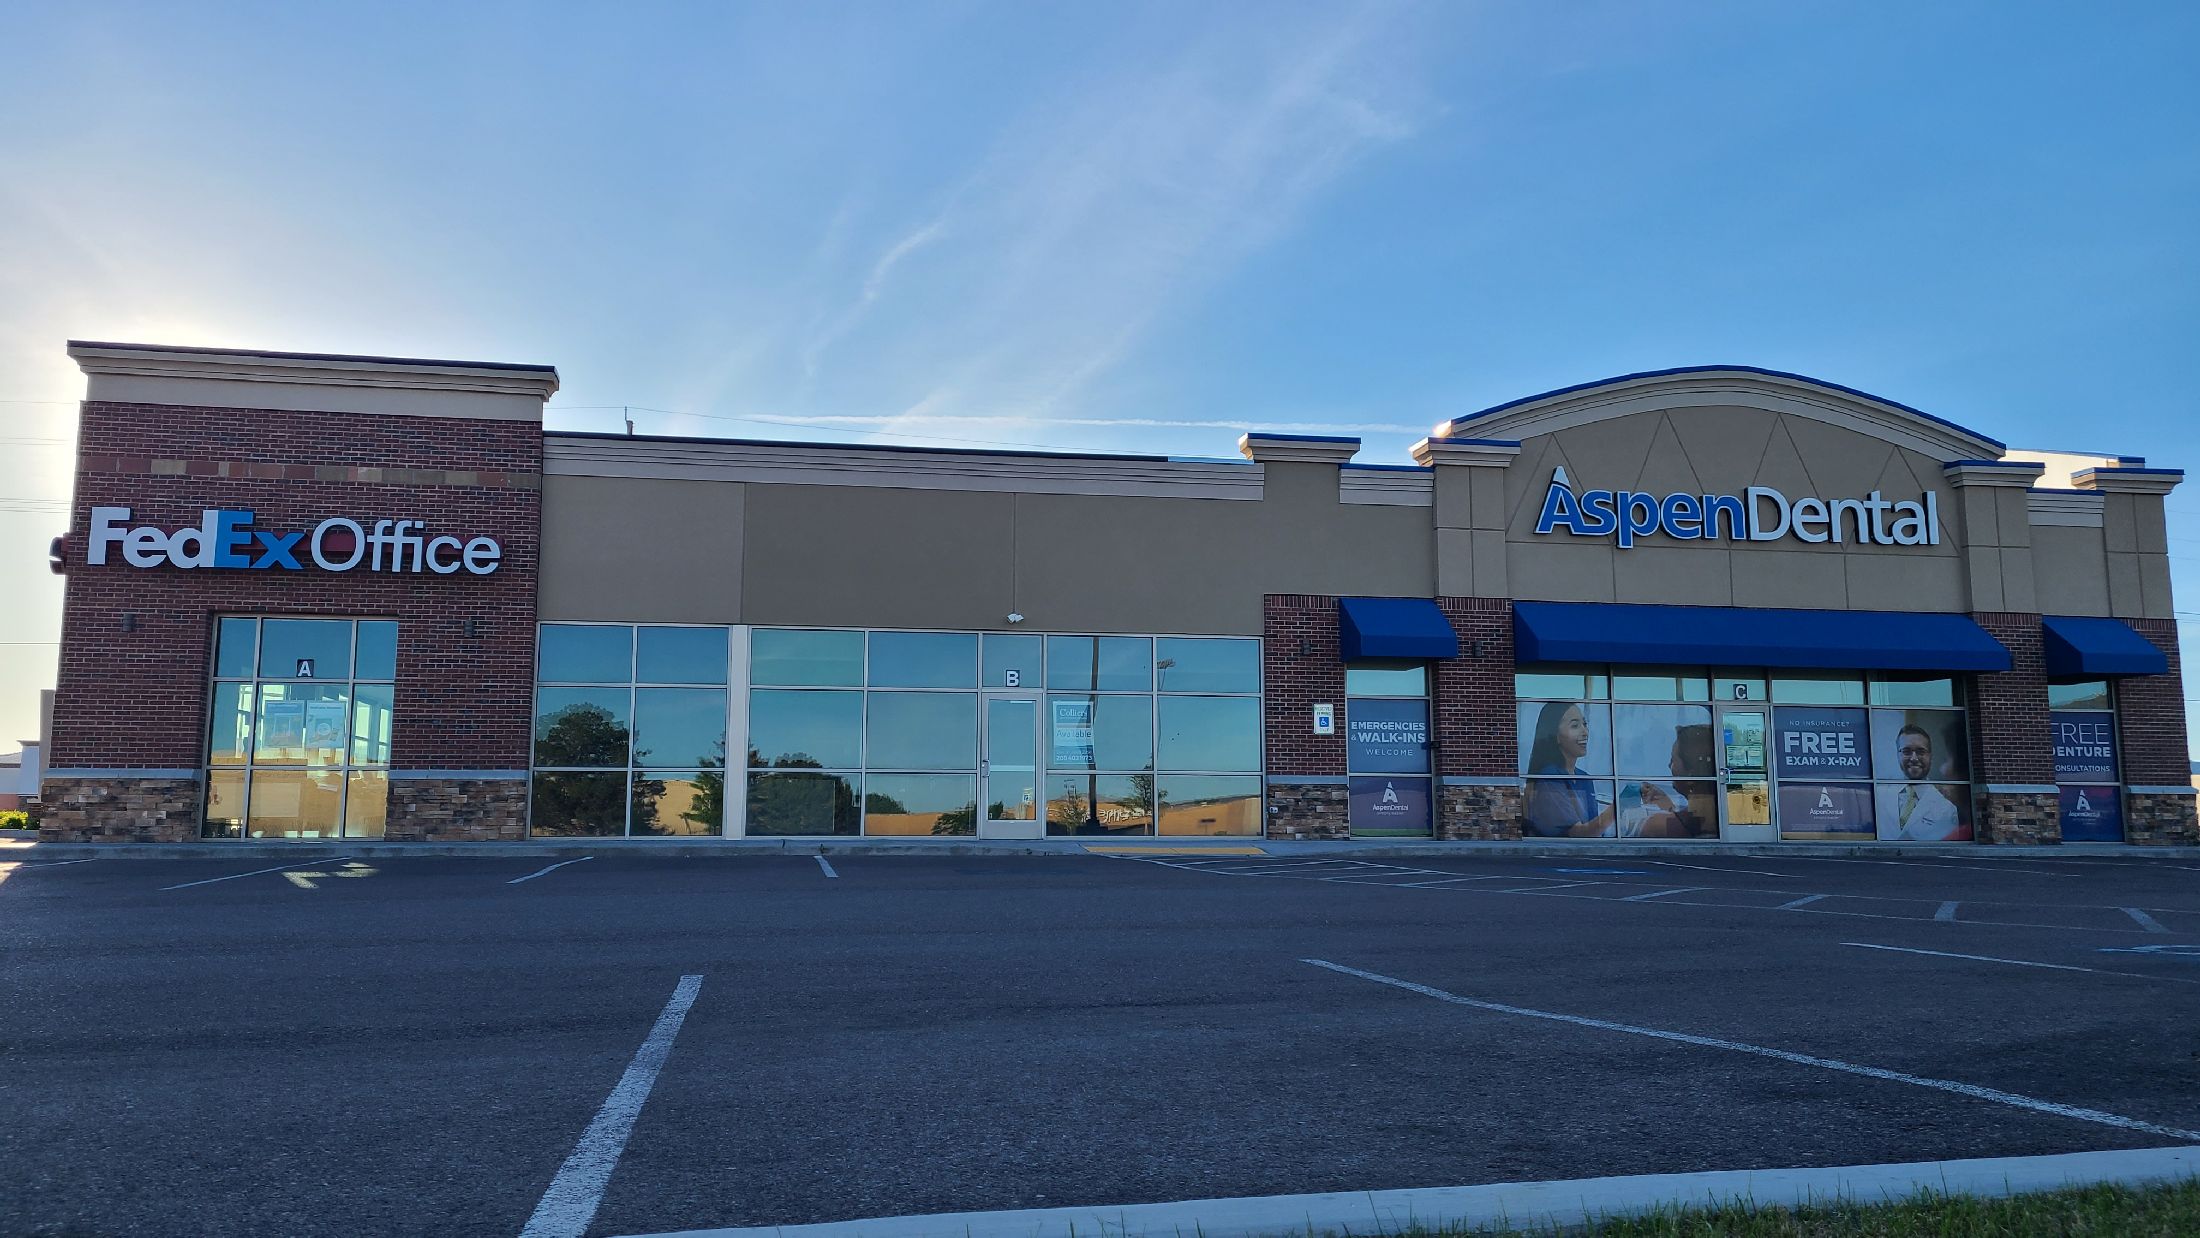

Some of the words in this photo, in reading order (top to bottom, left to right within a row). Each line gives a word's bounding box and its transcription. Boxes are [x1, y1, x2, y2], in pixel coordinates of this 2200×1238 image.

[87, 506, 306, 570] FedEx
[310, 517, 501, 575] Office
[297, 660, 313, 677] A
[1006, 670, 1019, 687] B
[1735, 685, 1747, 699] C
[1351, 721, 1426, 731] EMERGENCIES
[1358, 732, 1426, 743] WALK-INS
[1783, 731, 1856, 754] FREE
[1366, 748, 1414, 756] WELCOME
[1786, 756, 1819, 766] EXAM
[1827, 757, 1862, 766] X-RAY
[2055, 764, 2111, 772] ONSULTATIONS
